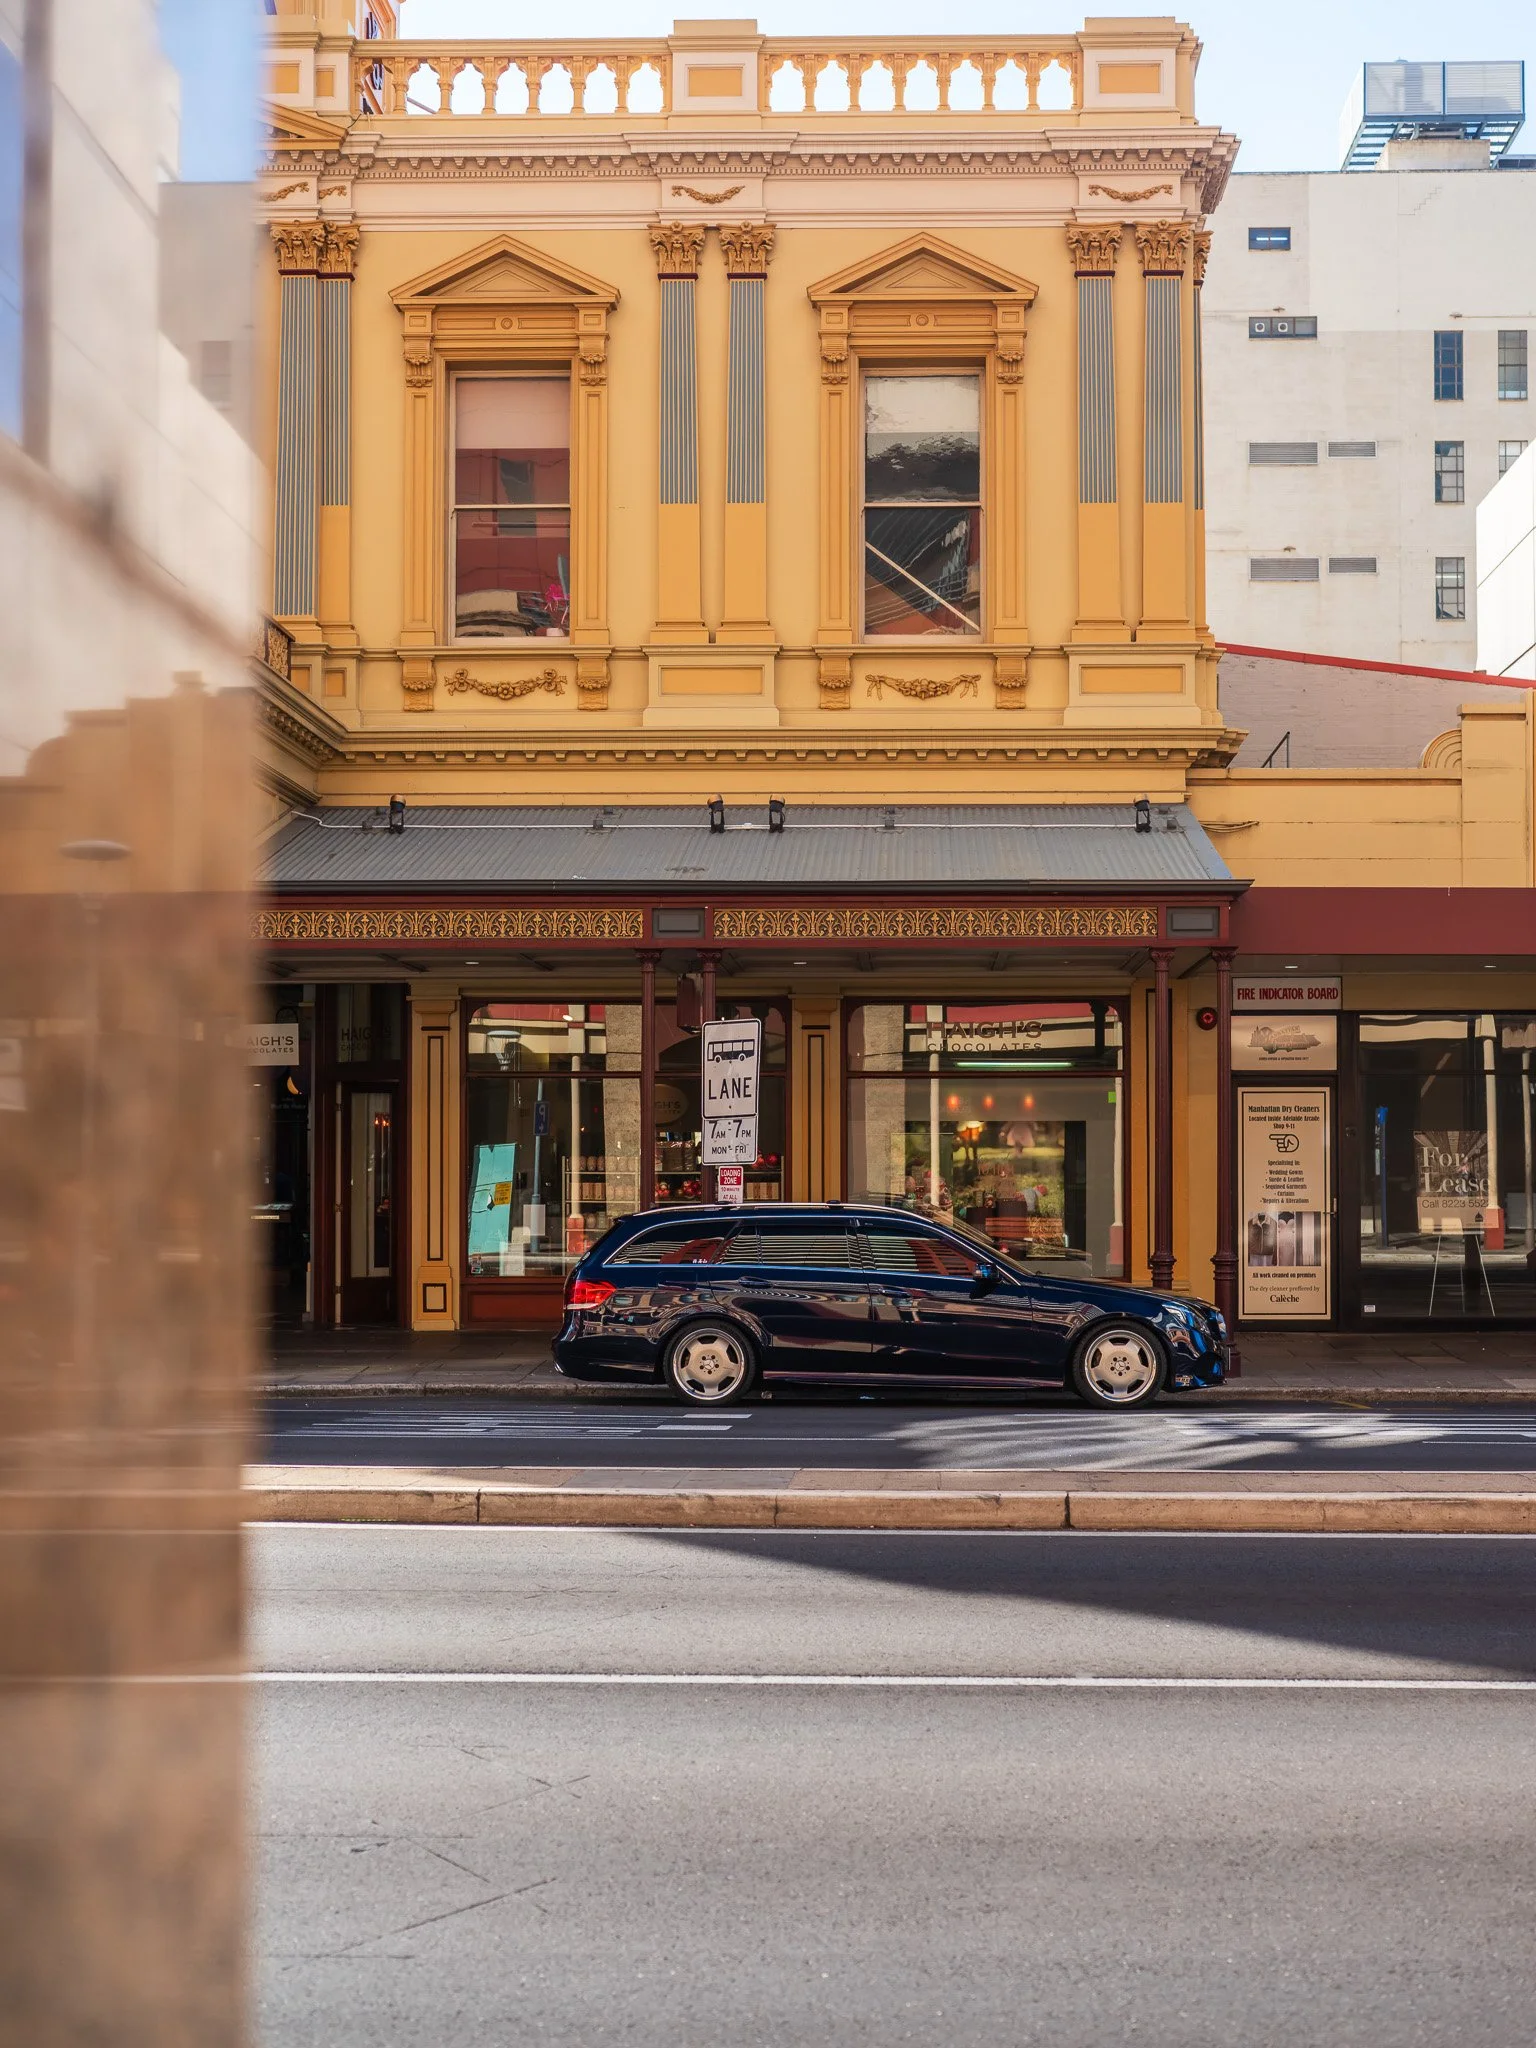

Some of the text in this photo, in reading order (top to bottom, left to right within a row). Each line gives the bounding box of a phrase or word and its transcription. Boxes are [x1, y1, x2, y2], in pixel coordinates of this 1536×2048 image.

[1237, 987, 1339, 1000] FIRE INDICATOR BOARD
[927, 1021, 1042, 1039] HAIGH'S
[246, 1036, 294, 1046] AIGH'S
[928, 1043, 1042, 1052] CHOCOLATES
[708, 1077, 752, 1100] LANE
[1248, 1105, 1320, 1114] Manhattan Dry Cleaners
[711, 1146, 727, 1155] MON
[735, 1145, 747, 1154] FRI
[1421, 1146, 1465, 1168] For
[721, 1169, 741, 1177] LOADING
[723, 1177, 737, 1185] ZONE
[1422, 1171, 1491, 1193] Lease
[1421, 1199, 1439, 1209] Call
[1441, 1199, 1466, 1208] 8223
[1259, 1285, 1269, 1293] dry
[1313, 1285, 1320, 1293] by
[1269, 1294, 1300, 1303] Calèche
